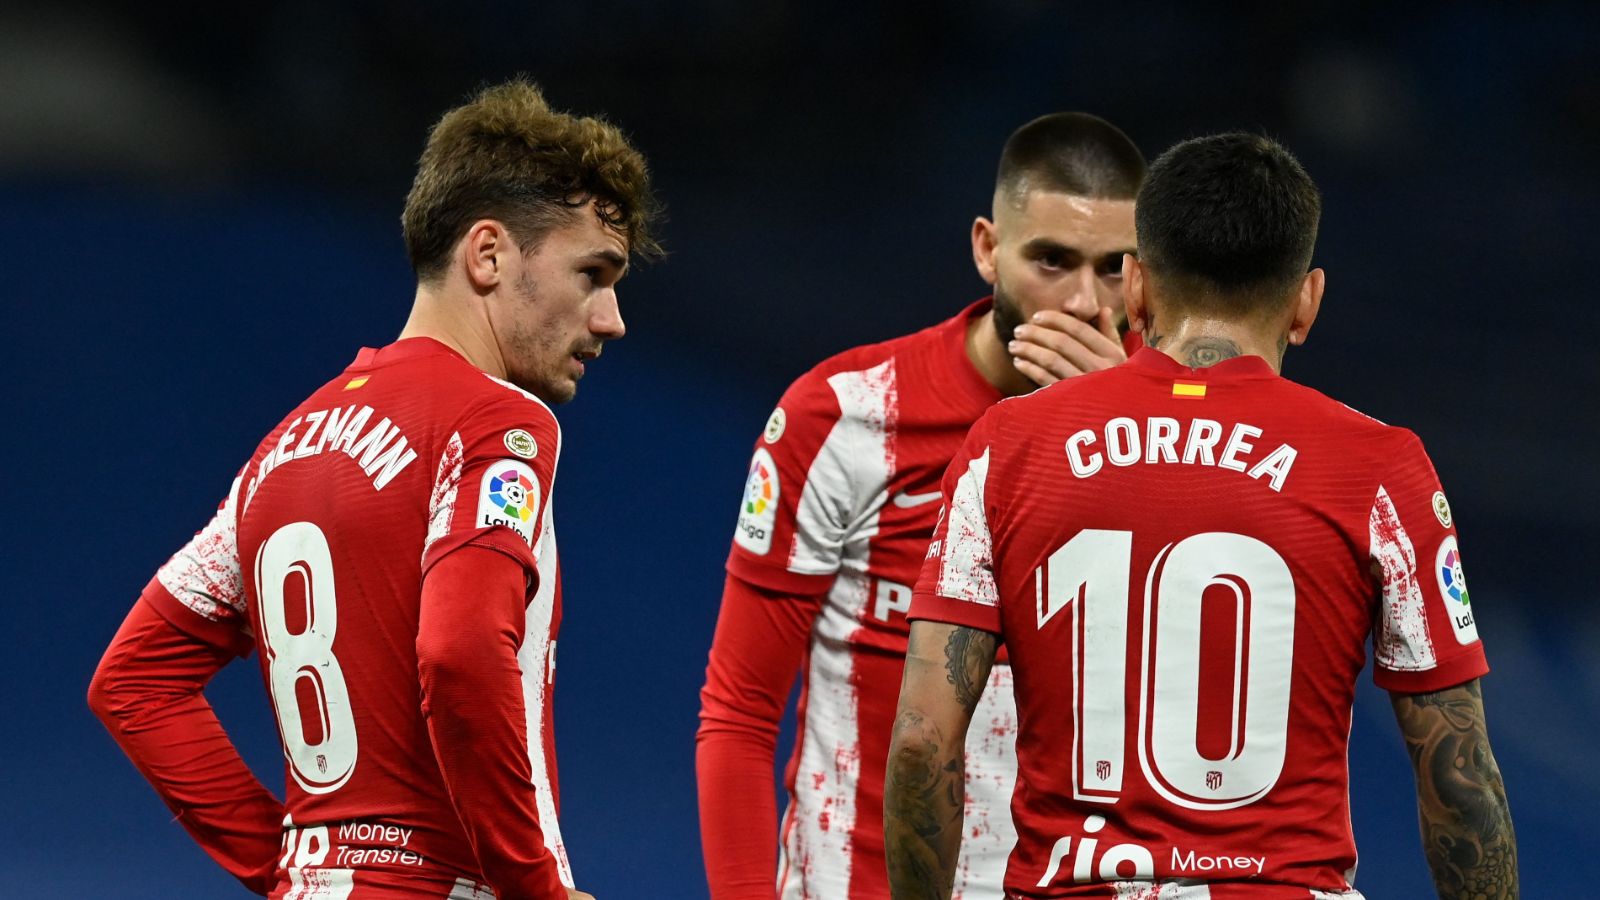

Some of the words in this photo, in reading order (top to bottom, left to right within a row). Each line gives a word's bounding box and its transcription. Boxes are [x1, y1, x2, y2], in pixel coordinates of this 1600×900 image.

[243, 404, 418, 516] EZMANN
[1065, 416, 1298, 492] CORREA
[254, 521, 358, 794] 8
[1035, 529, 1296, 811] 10
[339, 821, 412, 847] Money
[1171, 847, 1265, 873] Money
